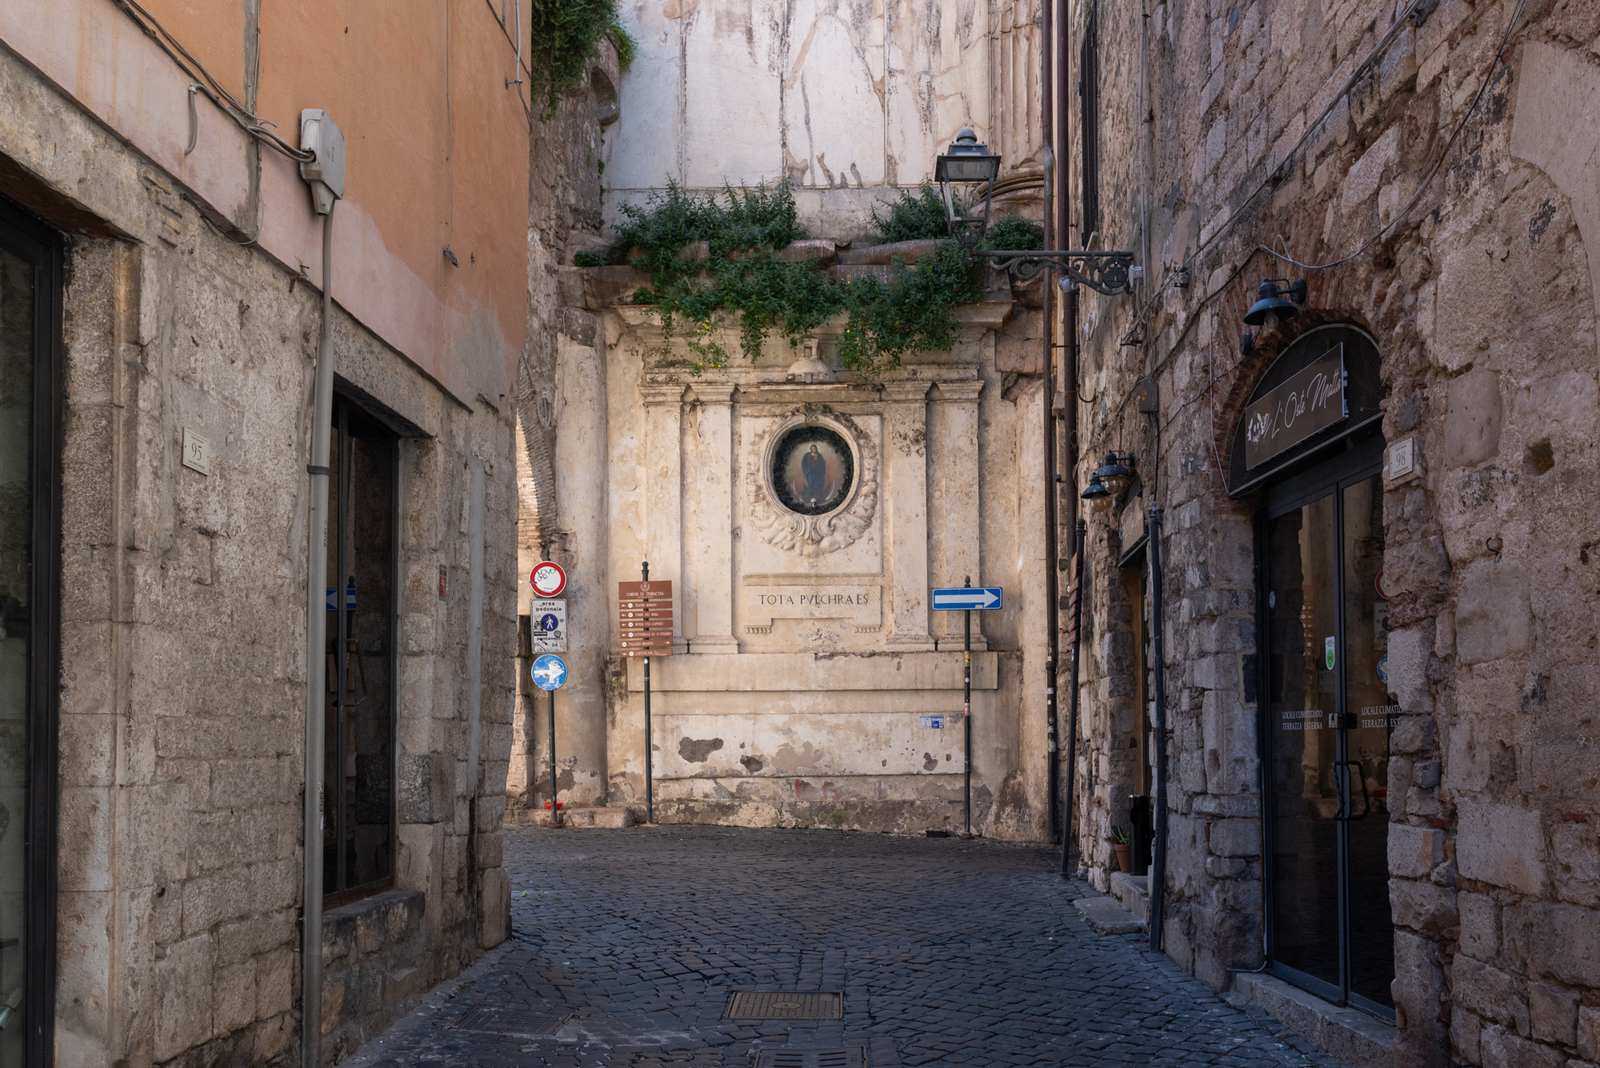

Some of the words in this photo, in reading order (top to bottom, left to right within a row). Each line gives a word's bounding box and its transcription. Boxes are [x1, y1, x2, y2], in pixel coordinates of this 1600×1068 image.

[191, 443, 202, 461] 95
[759, 594, 795, 606] TOTA
[856, 594, 869, 606] ES
